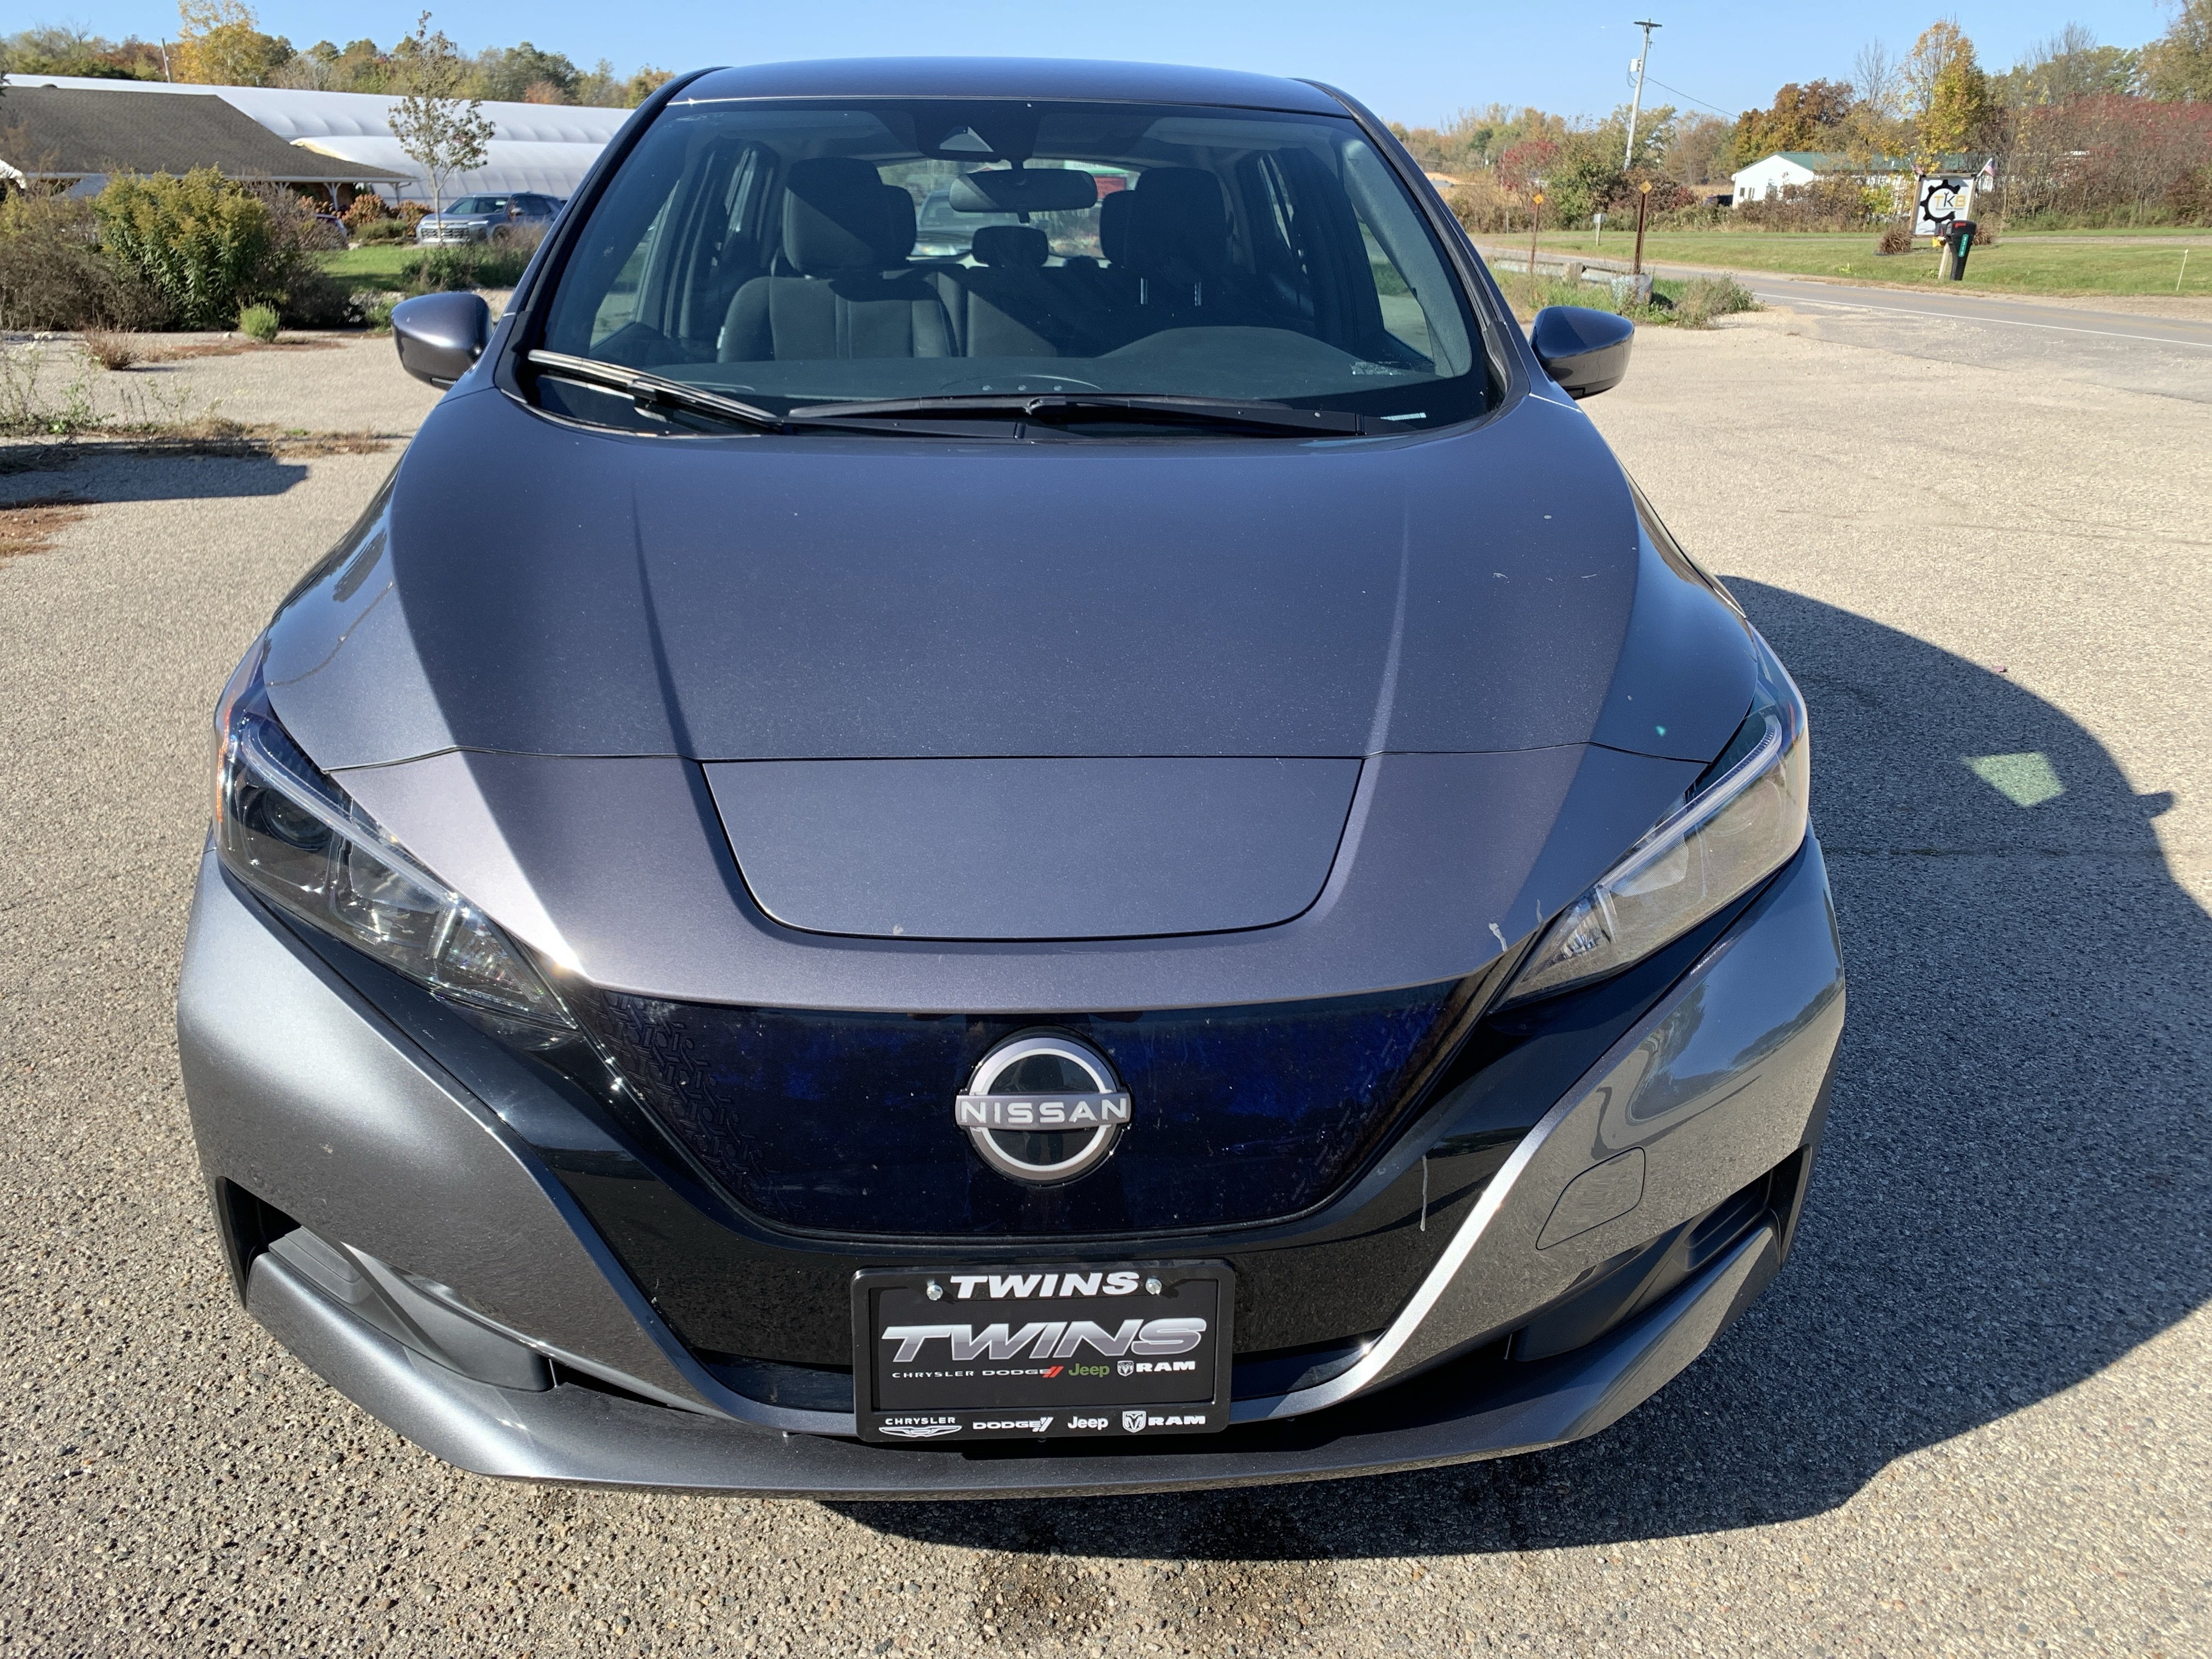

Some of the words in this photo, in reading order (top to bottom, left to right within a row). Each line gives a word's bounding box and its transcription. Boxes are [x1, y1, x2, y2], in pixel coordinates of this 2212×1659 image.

[1934, 191, 1966, 207] TKB
[961, 1098, 1127, 1124] NISSAN
[950, 1271, 1140, 1299] TWINS
[881, 1317, 1207, 1362] TWINS
[891, 1370, 974, 1379] CHRYSLER
[982, 1368, 1052, 1376] DODGE
[1068, 1363, 1110, 1378] Jeep
[1136, 1361, 1196, 1372] RAM
[885, 1417, 956, 1425] CHRYSLER
[973, 1420, 1042, 1430] DODGE
[1067, 1415, 1109, 1430] Jeep
[1148, 1415, 1206, 1426] RAM
